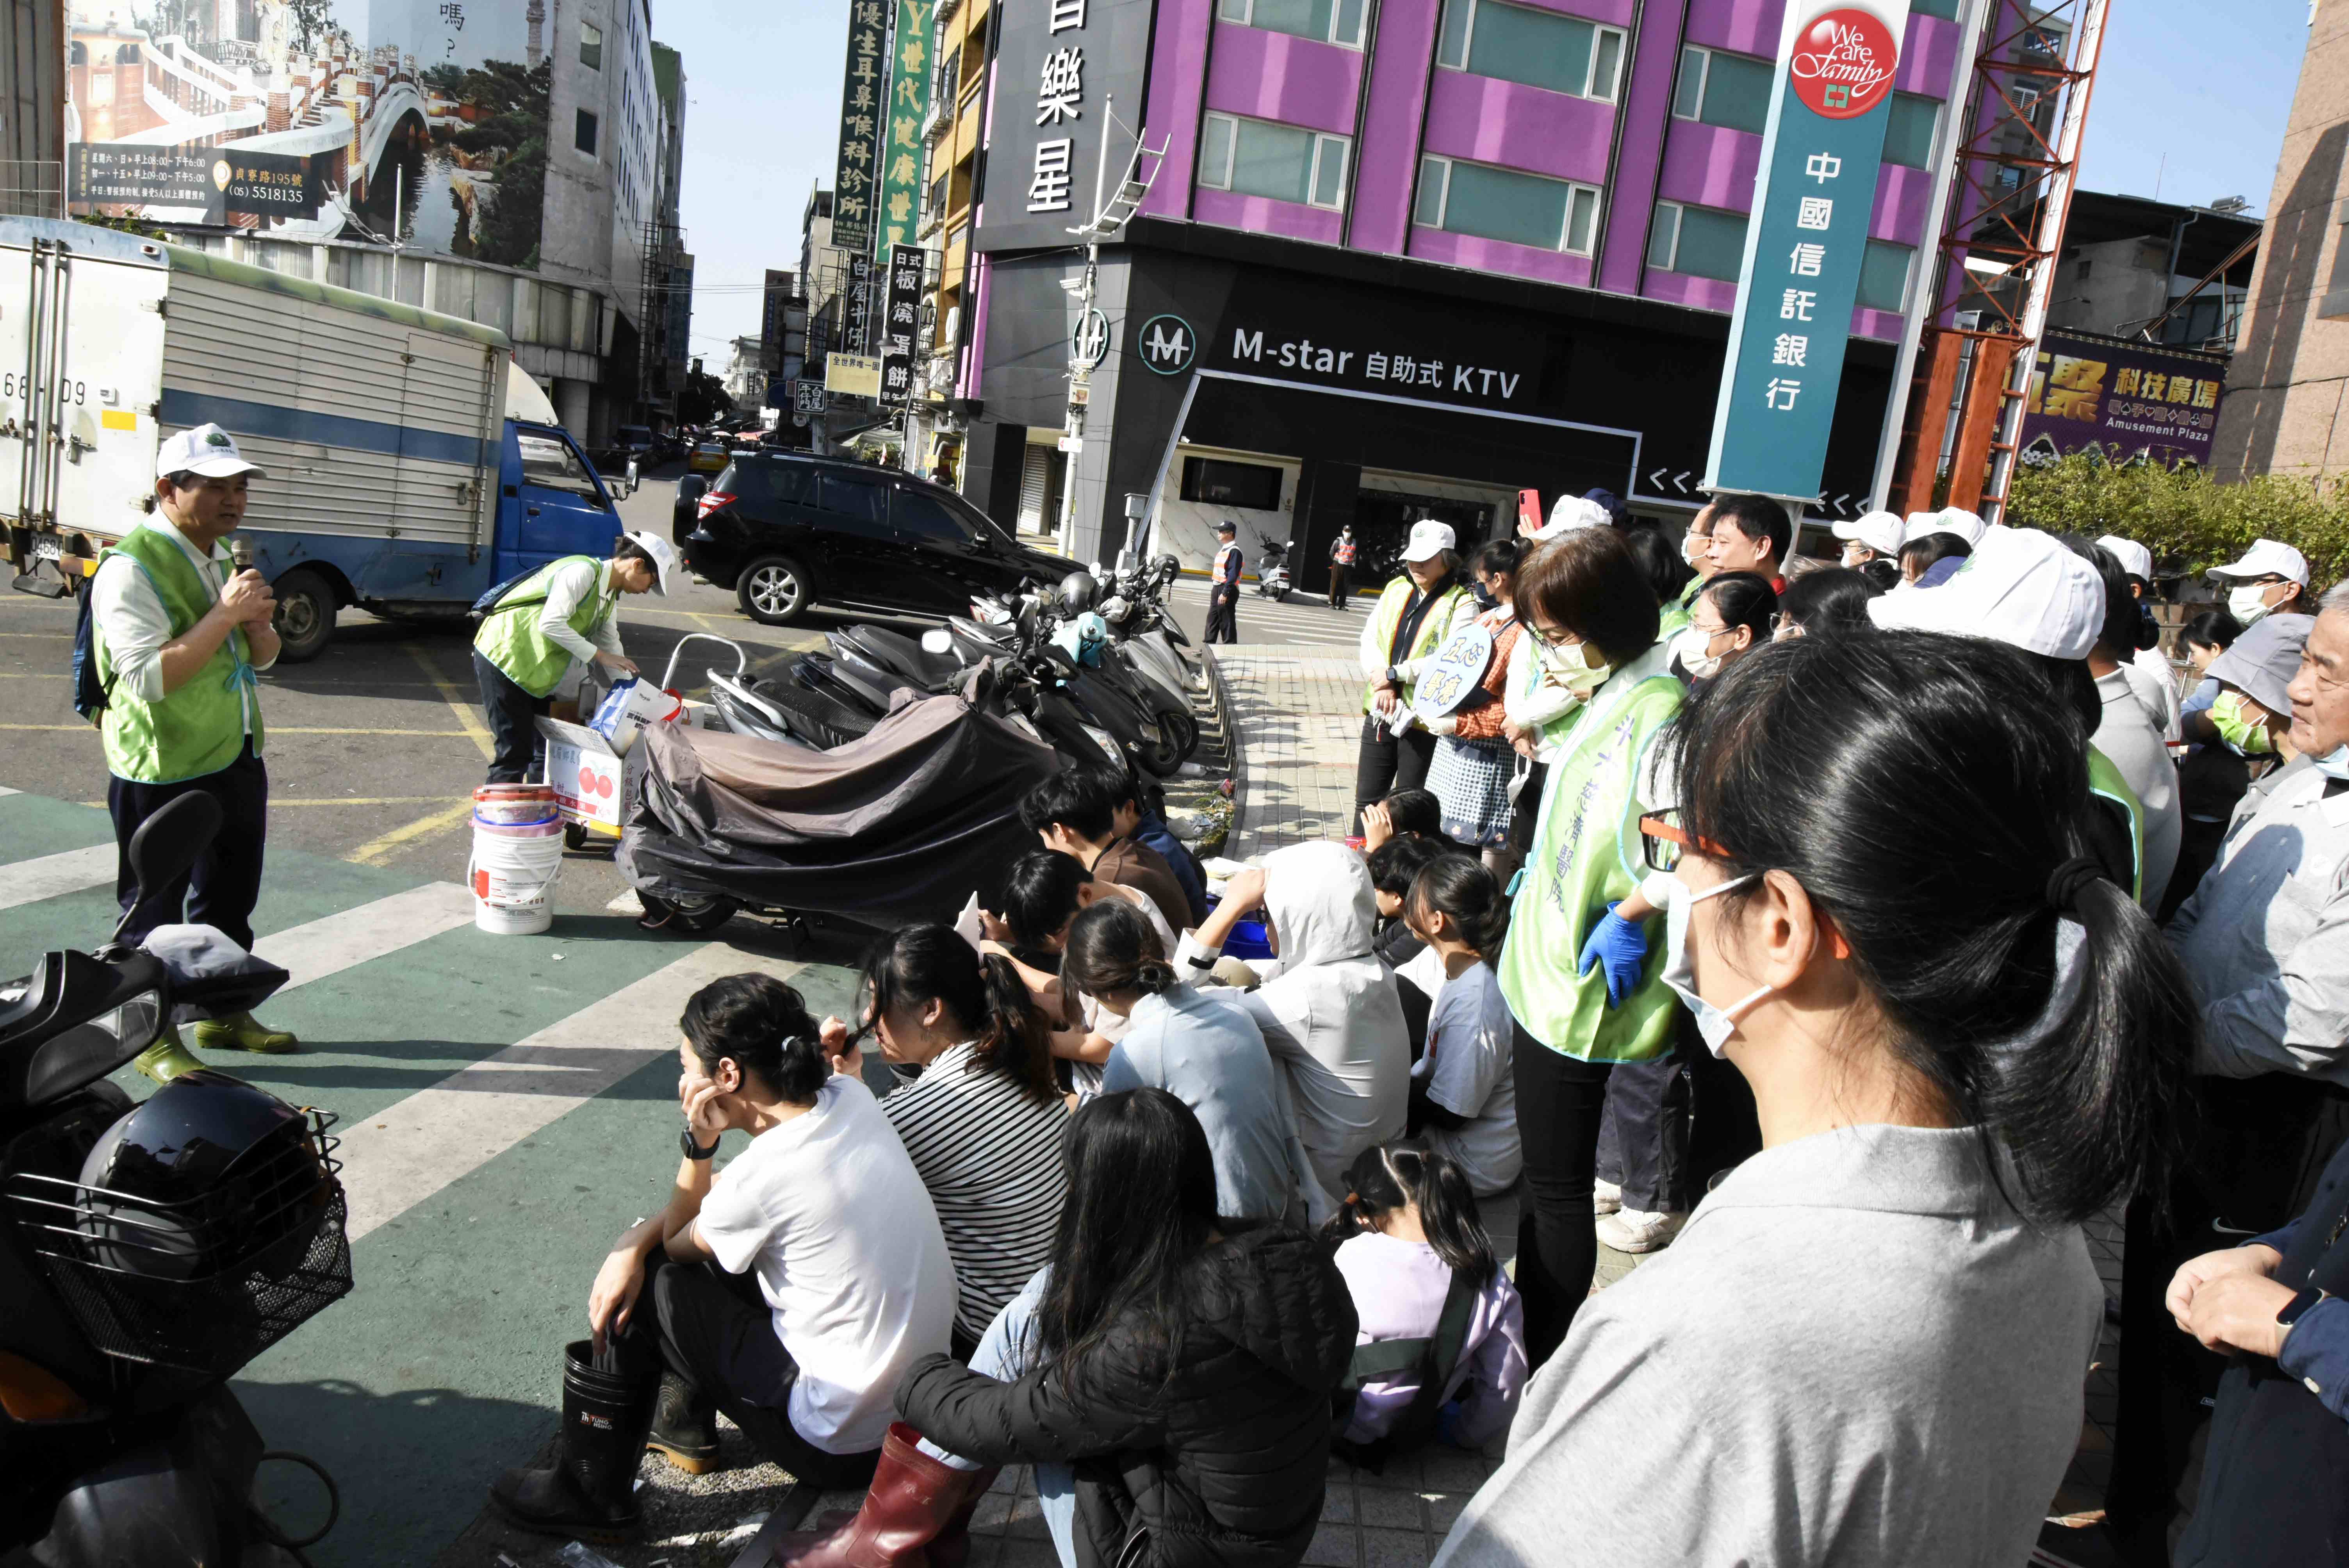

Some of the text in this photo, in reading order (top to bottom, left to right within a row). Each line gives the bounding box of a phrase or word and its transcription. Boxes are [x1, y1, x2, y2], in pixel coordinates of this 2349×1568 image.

[1830, 24, 1864, 47] We
[1792, 44, 1896, 97] Family
[839, 1, 884, 221] 優生耳鼻喉科診所
[229, 184, 303, 203] (05) 5518135
[896, 253, 921, 267] 日式
[1765, 152, 1841, 411] 中國信託銀行
[1233, 328, 1520, 399] M-star 自助式 KTV
[2114, 368, 2220, 409] 科技廣場
[2106, 417, 2208, 442] Amusement Plaza
